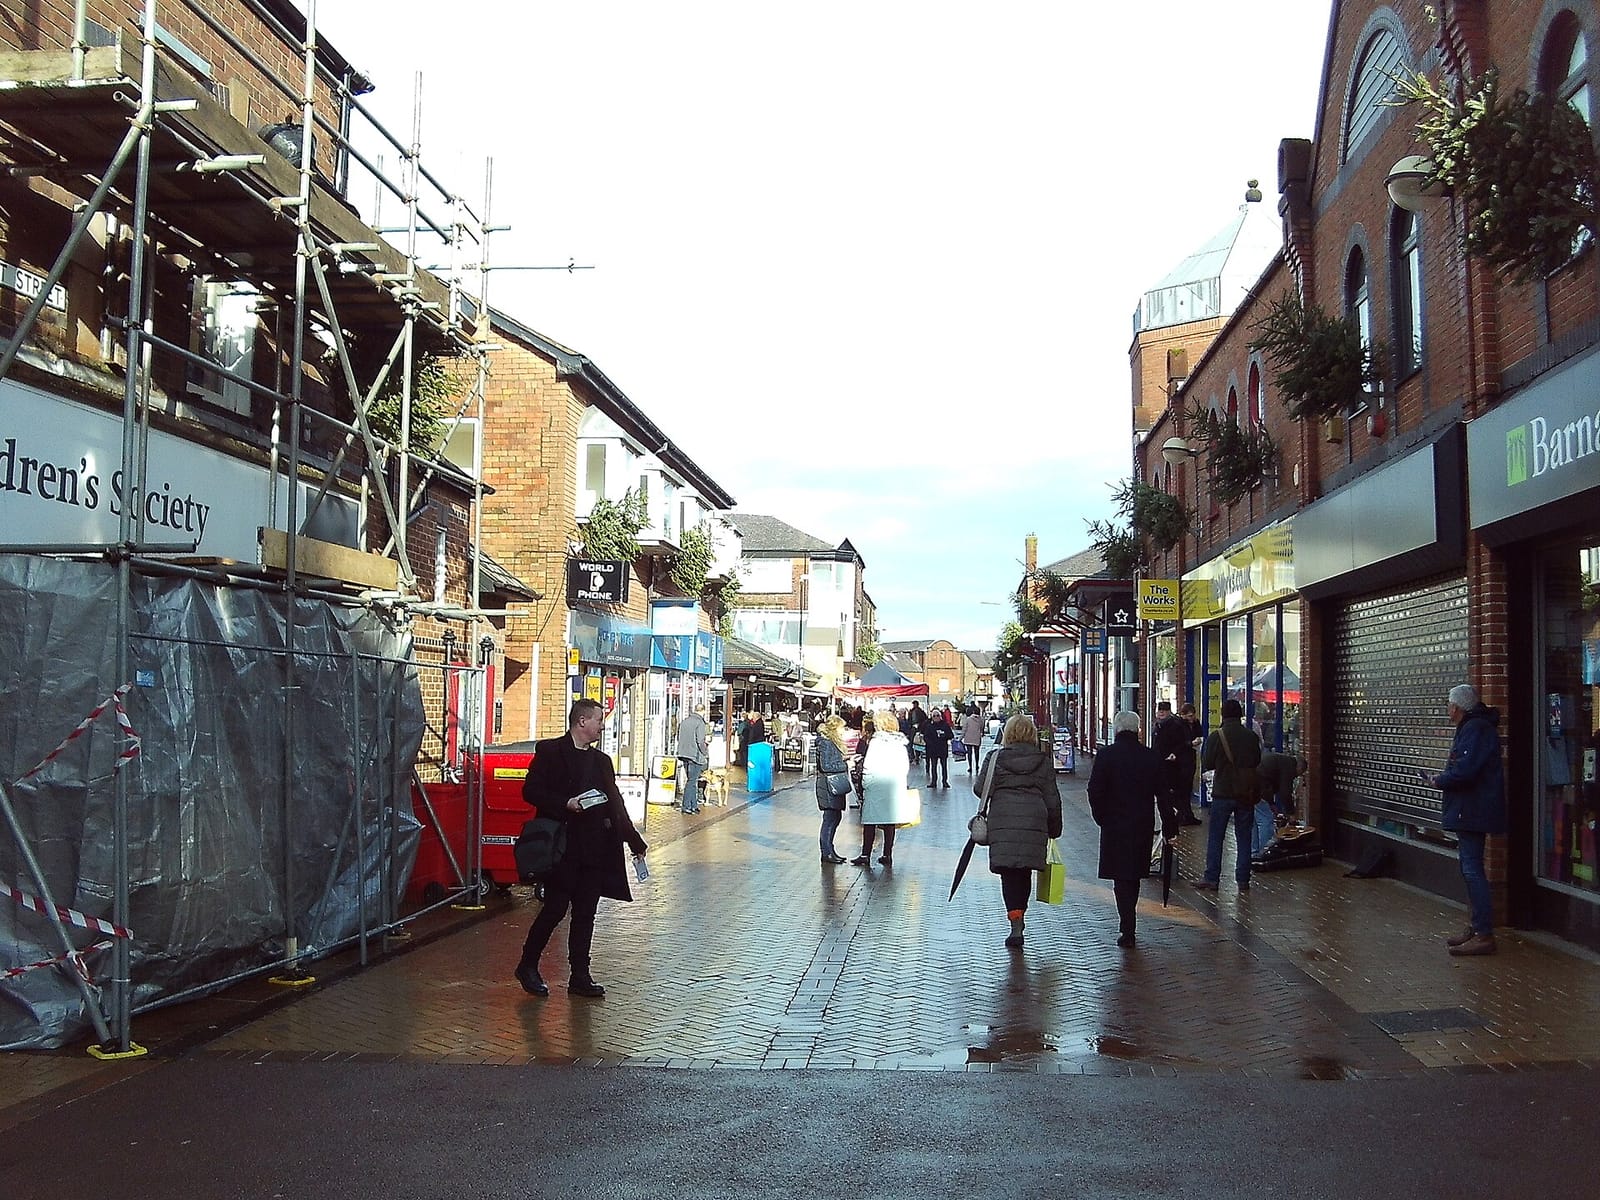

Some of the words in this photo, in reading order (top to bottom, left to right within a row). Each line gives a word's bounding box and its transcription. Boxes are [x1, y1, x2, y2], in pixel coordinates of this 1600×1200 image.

[579, 562, 614, 572] WORLD
[1149, 585, 1168, 594] The
[577, 590, 613, 600] PHONE
[1143, 596, 1174, 605] Works
